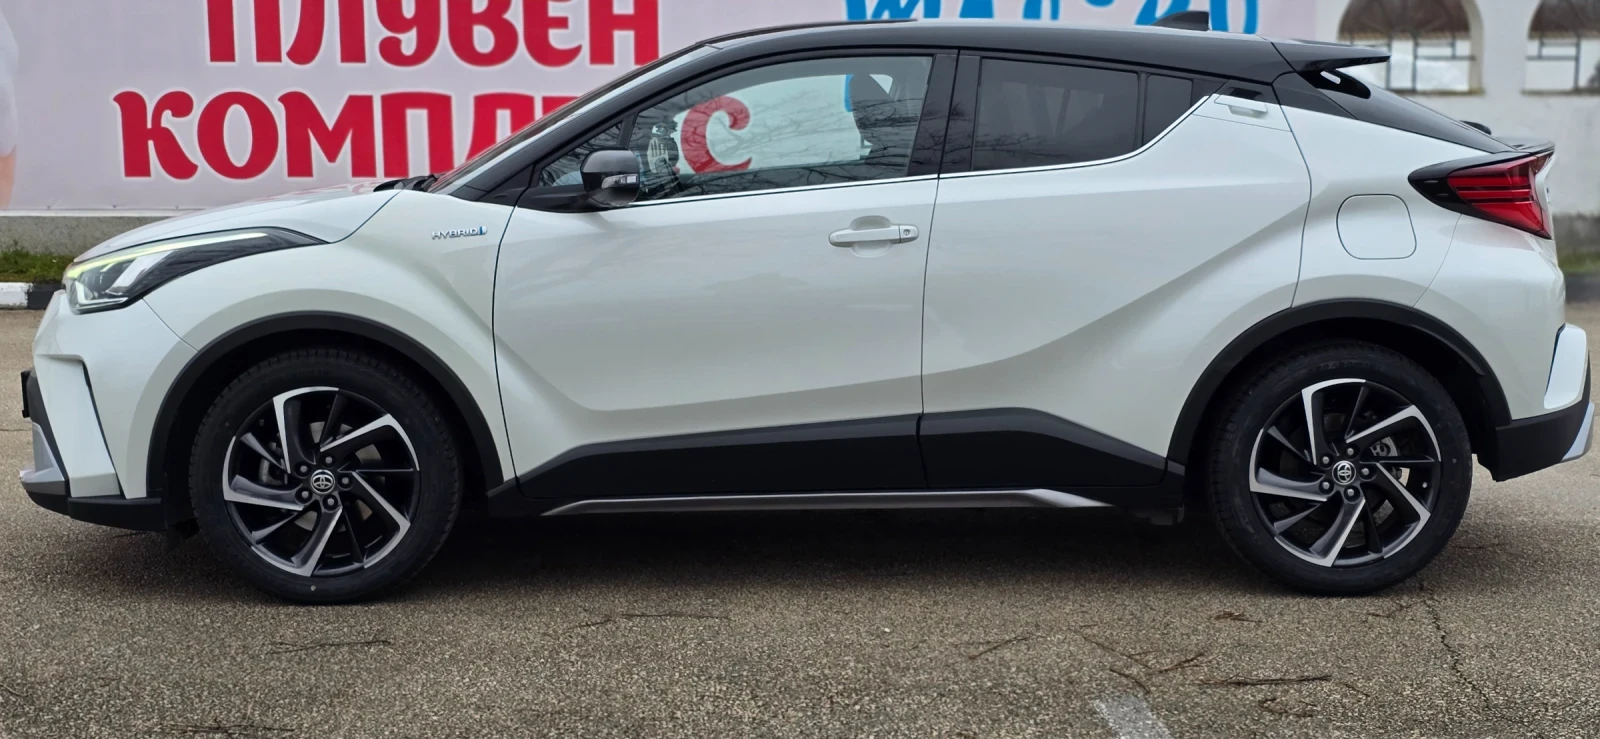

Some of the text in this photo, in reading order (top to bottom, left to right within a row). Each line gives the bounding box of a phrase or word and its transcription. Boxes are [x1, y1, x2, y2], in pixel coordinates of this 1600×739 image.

[207, 0, 660, 67] ПЛУВЕН
[113, 90, 752, 179] КОМПЛС
[431, 227, 478, 240] HYBRID
